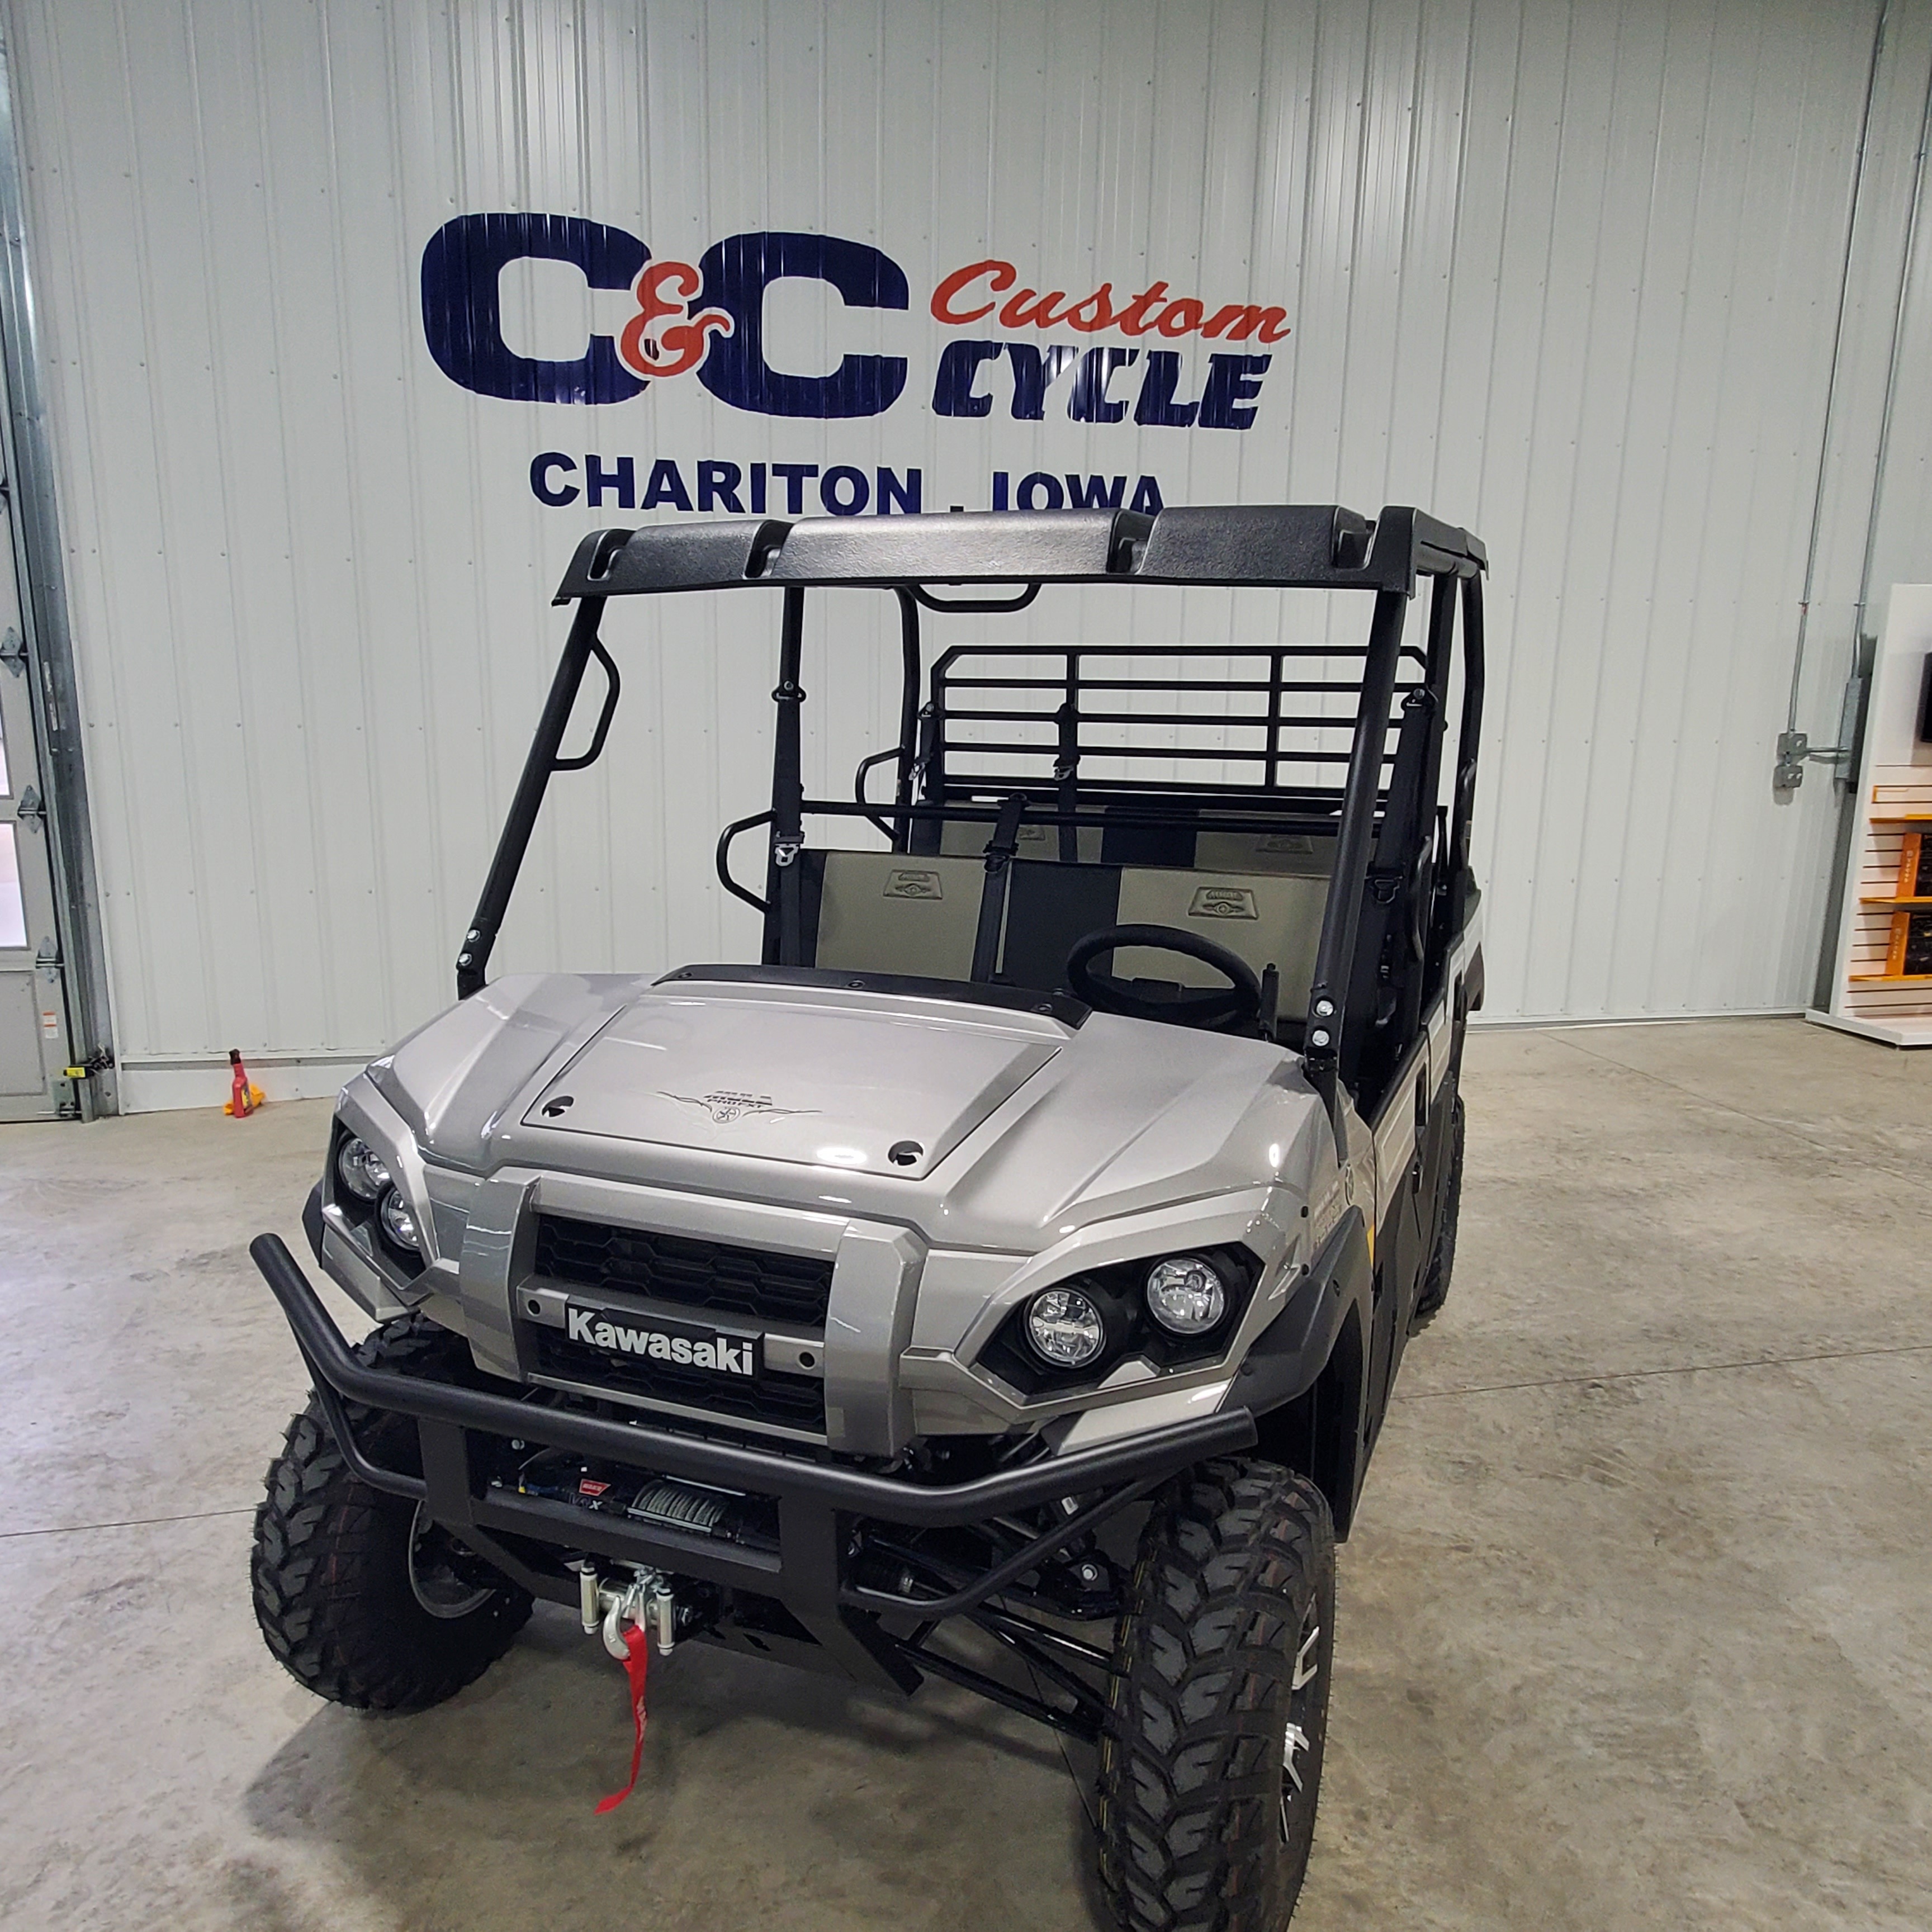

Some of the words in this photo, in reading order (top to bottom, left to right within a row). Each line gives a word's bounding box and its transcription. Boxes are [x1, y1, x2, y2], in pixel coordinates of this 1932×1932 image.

[420, 212, 910, 419] C&C
[930, 259, 1291, 343] Custom
[931, 340, 1272, 430] CYCLE
[529, 452, 922, 516] CHARITON
[992, 471, 1165, 516] IOWA
[568, 1307, 753, 1376] Kawasaki
